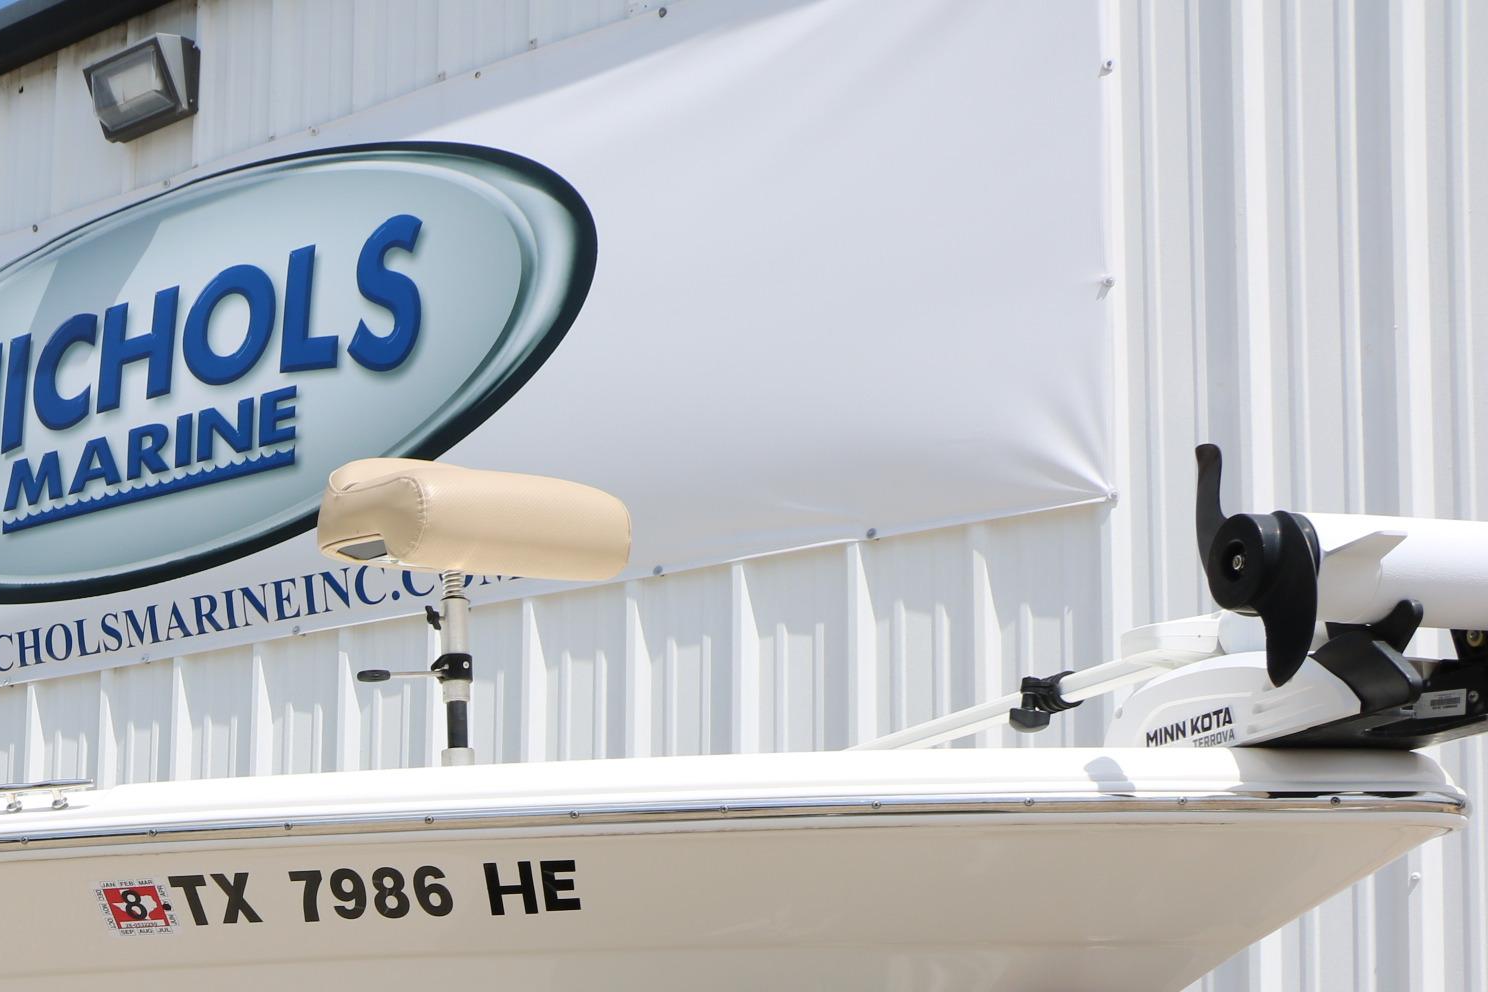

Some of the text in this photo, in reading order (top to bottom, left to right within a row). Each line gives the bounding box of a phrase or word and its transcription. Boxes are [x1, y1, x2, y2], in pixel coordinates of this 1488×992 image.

[3, 385, 298, 512] MARINE
[1146, 706, 1234, 748] MINN KOTA
[121, 889, 148, 921] 8
[168, 859, 582, 926] TX 7986 HE
